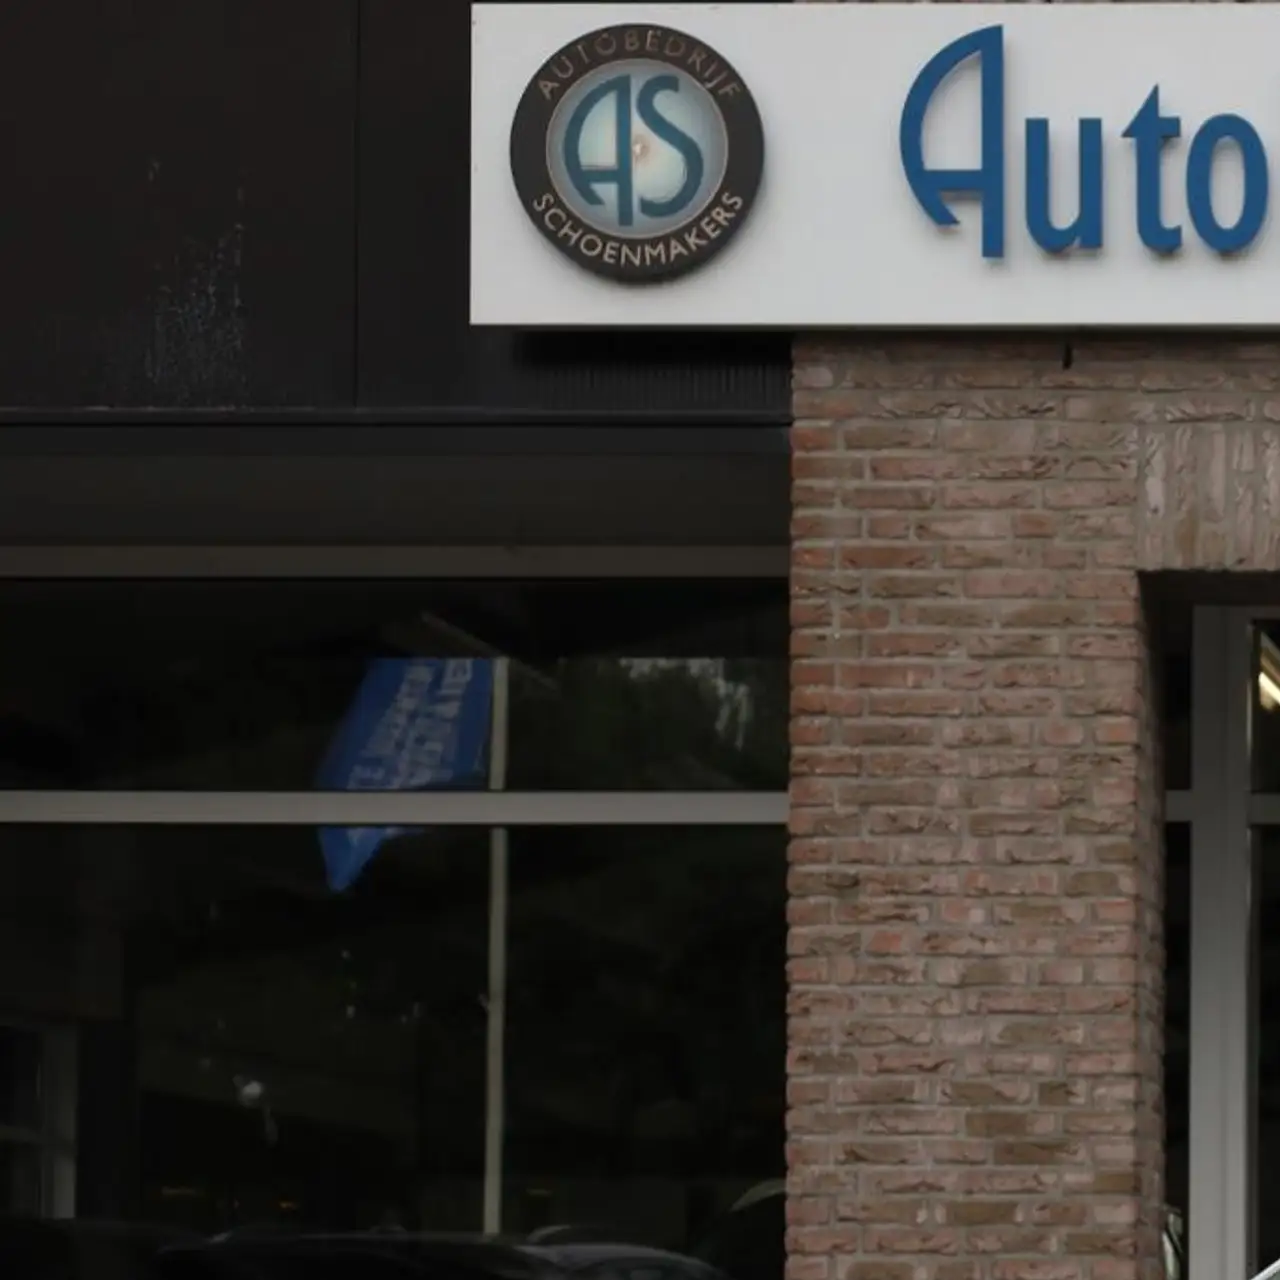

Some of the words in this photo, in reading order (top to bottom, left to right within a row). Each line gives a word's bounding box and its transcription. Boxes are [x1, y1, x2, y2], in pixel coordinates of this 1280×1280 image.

[537, 29, 742, 101] AUTOBEDRIJF
[563, 73, 704, 226] AS
[533, 192, 743, 267] SCHOENMAKERS
